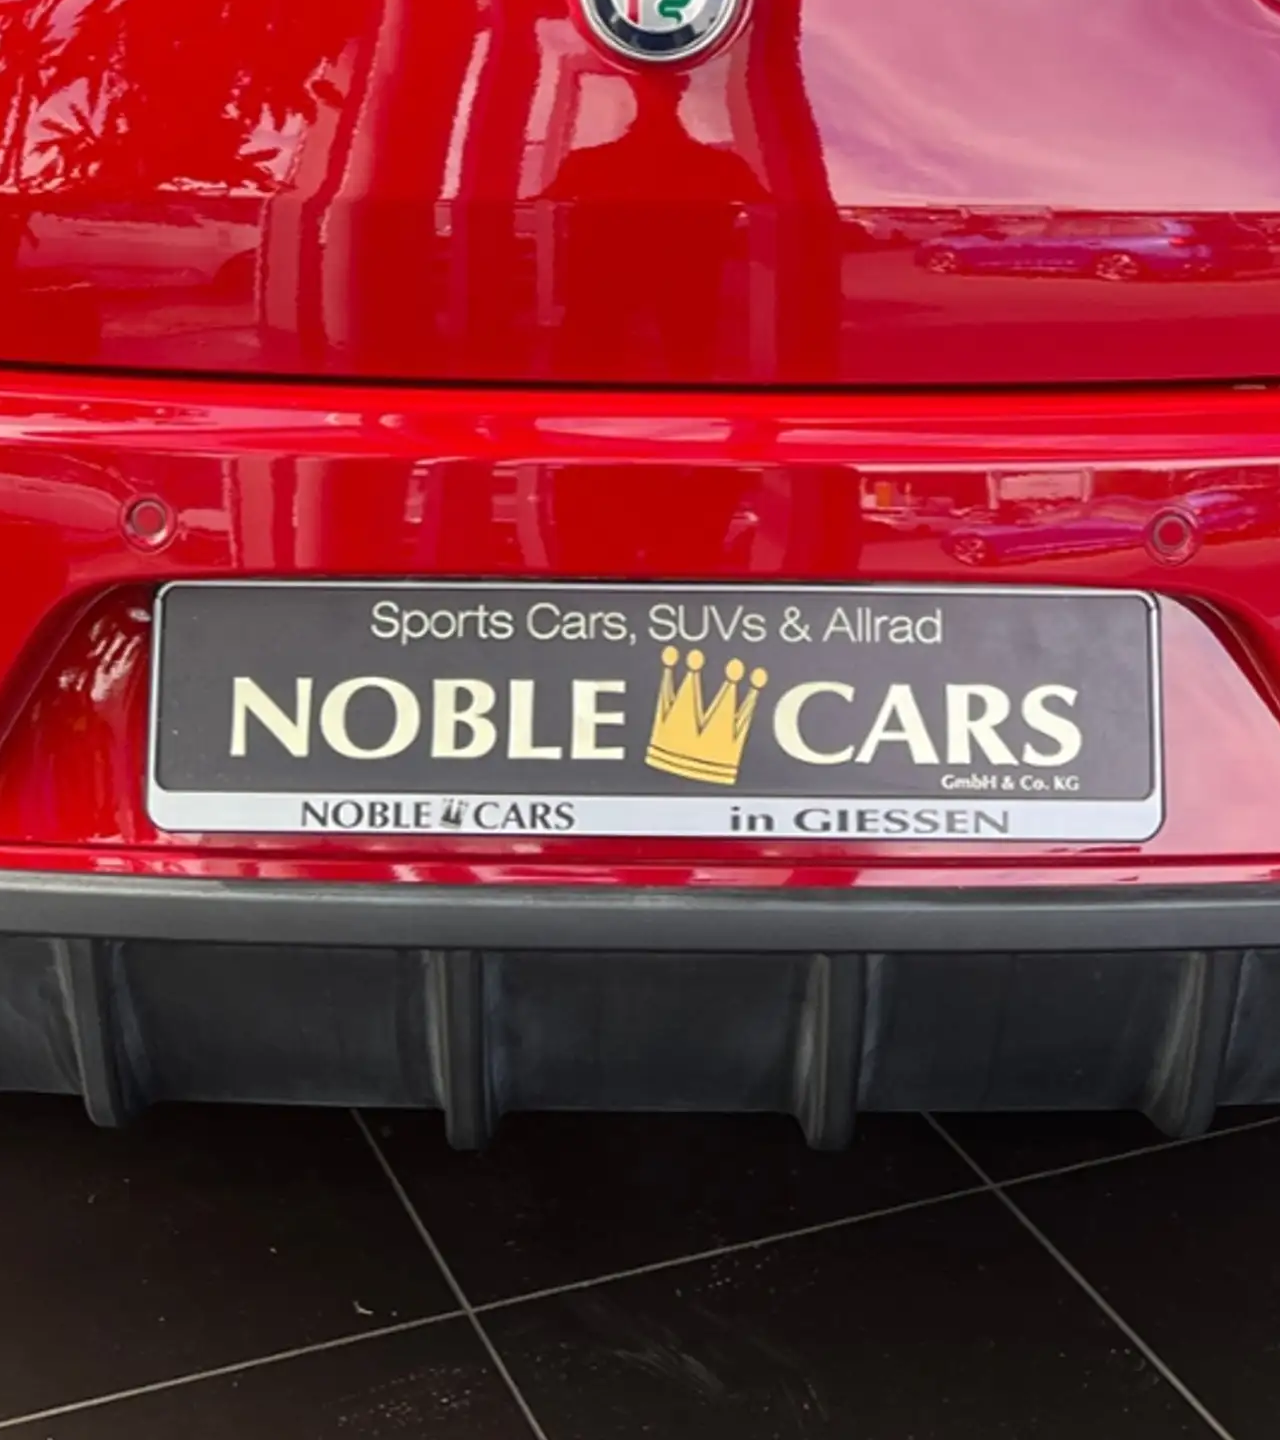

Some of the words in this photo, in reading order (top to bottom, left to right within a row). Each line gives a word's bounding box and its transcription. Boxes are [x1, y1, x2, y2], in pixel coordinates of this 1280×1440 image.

[370, 600, 514, 645] Sports
[526, 602, 637, 646] Cars,
[648, 603, 767, 642] SUVs
[778, 606, 813, 643] &
[822, 606, 943, 644] Allrad
[230, 675, 627, 760] NOBLE
[773, 680, 1083, 767] CARS
[940, 772, 998, 791] GmbH
[1000, 774, 1016, 791] &
[1019, 774, 1050, 792] Co.
[1053, 774, 1080, 792] KG
[300, 799, 433, 829] NOBLE
[473, 801, 576, 830] CARS
[730, 805, 775, 833] in
[793, 807, 1009, 834] GIESSEN
